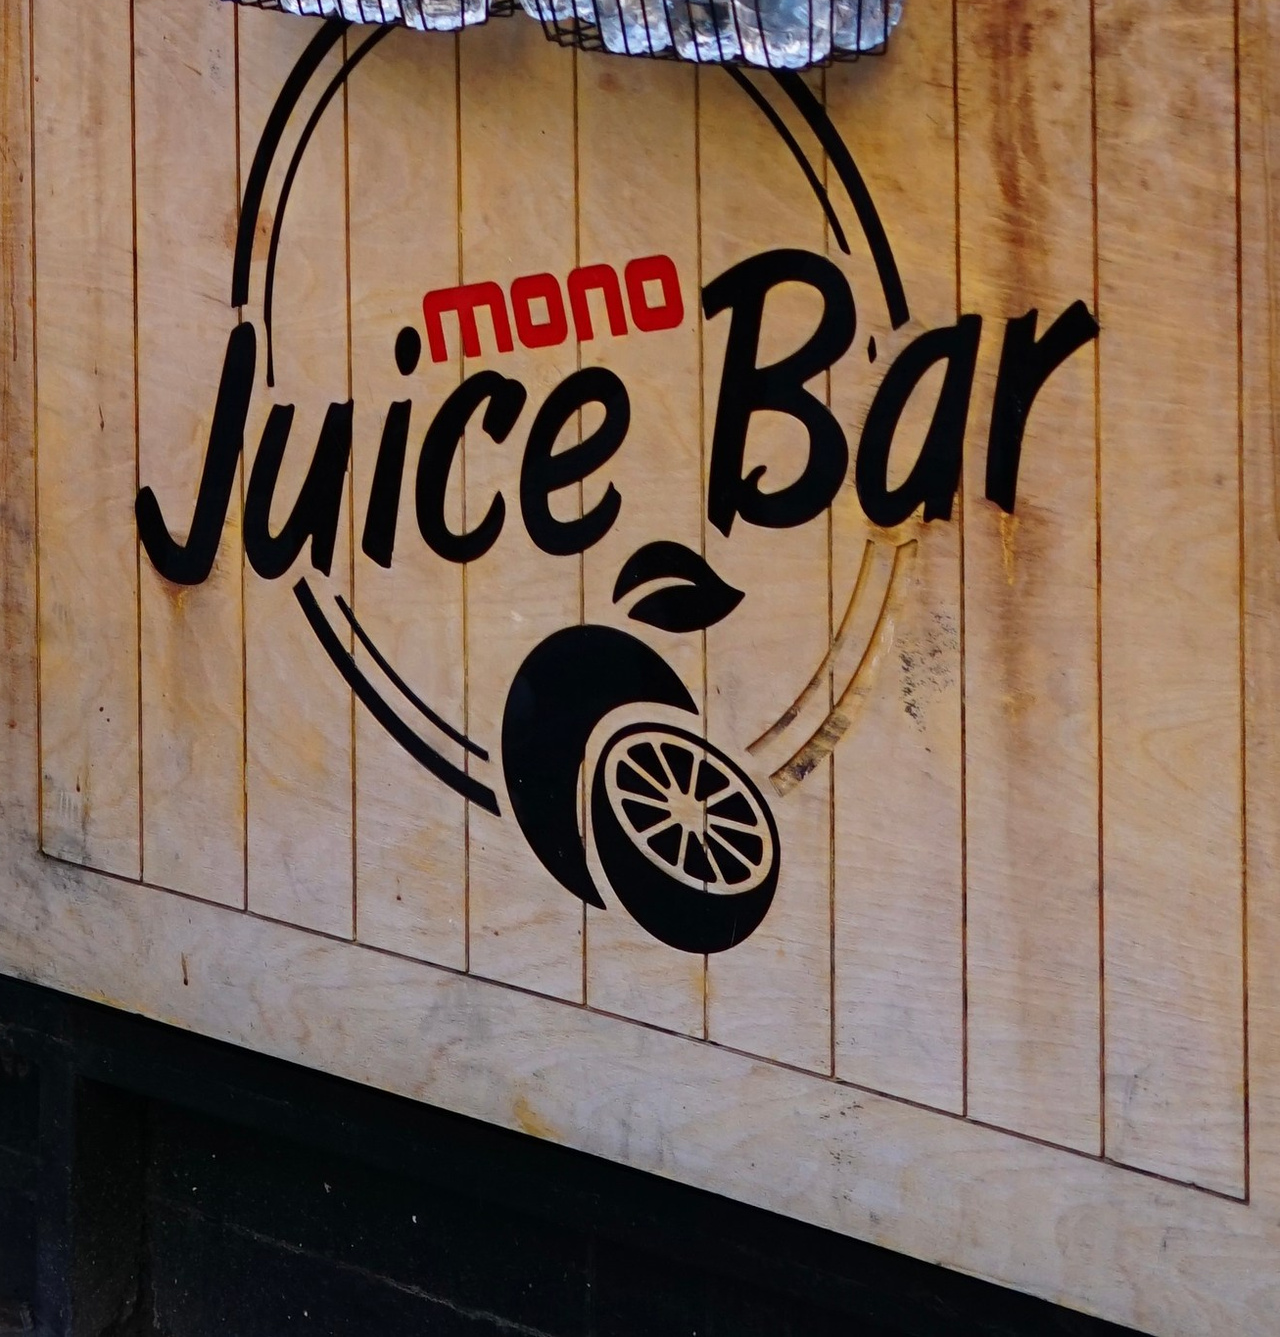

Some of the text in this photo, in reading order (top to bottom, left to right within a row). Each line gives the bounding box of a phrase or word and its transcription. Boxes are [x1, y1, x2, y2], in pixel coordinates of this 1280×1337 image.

[134, 248, 1101, 587] Juice Bar
[422, 254, 685, 364] mono
